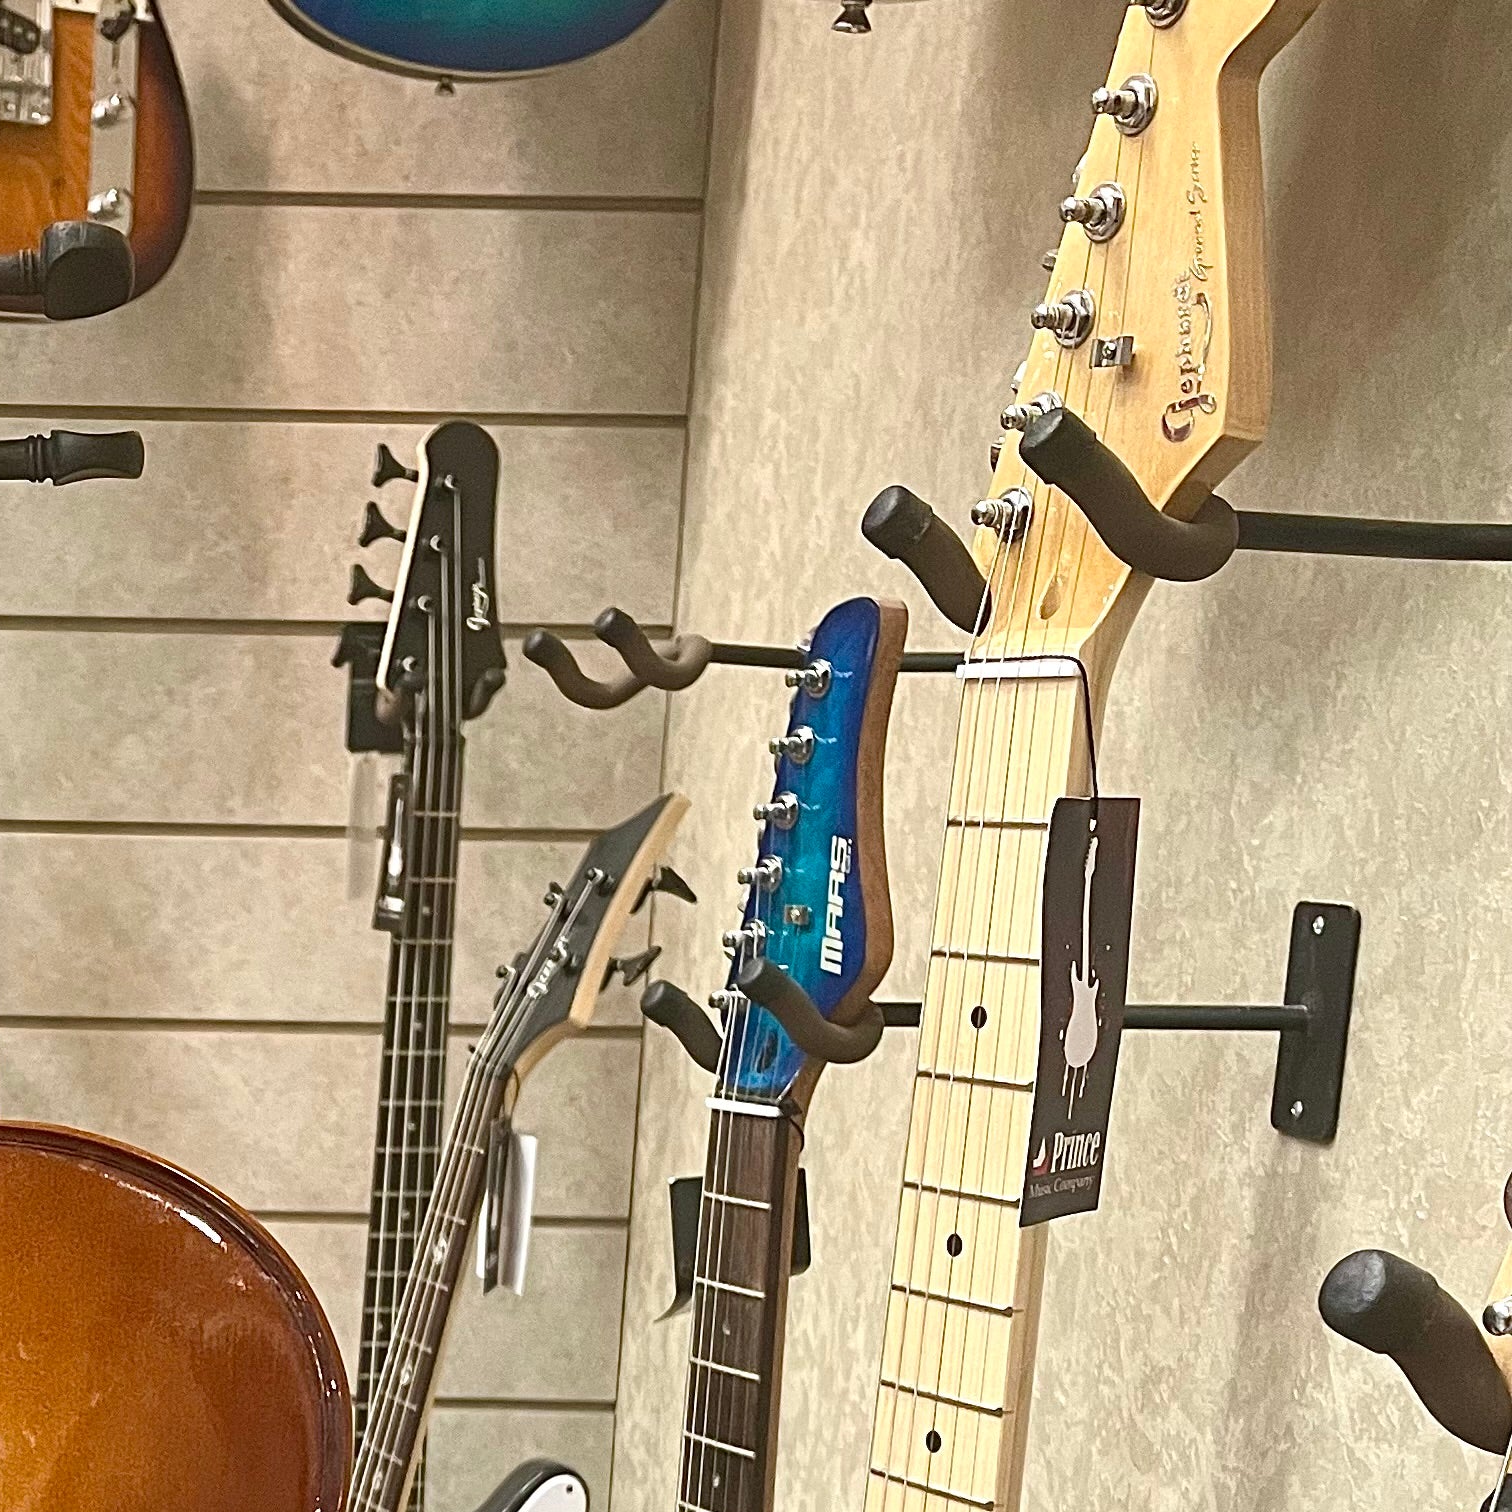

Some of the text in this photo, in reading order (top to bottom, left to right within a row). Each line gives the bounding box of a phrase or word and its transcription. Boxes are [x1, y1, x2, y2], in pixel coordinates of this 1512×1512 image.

[1050, 1131, 1101, 1173] Prince
[1029, 1176, 1096, 1198] Music Company
